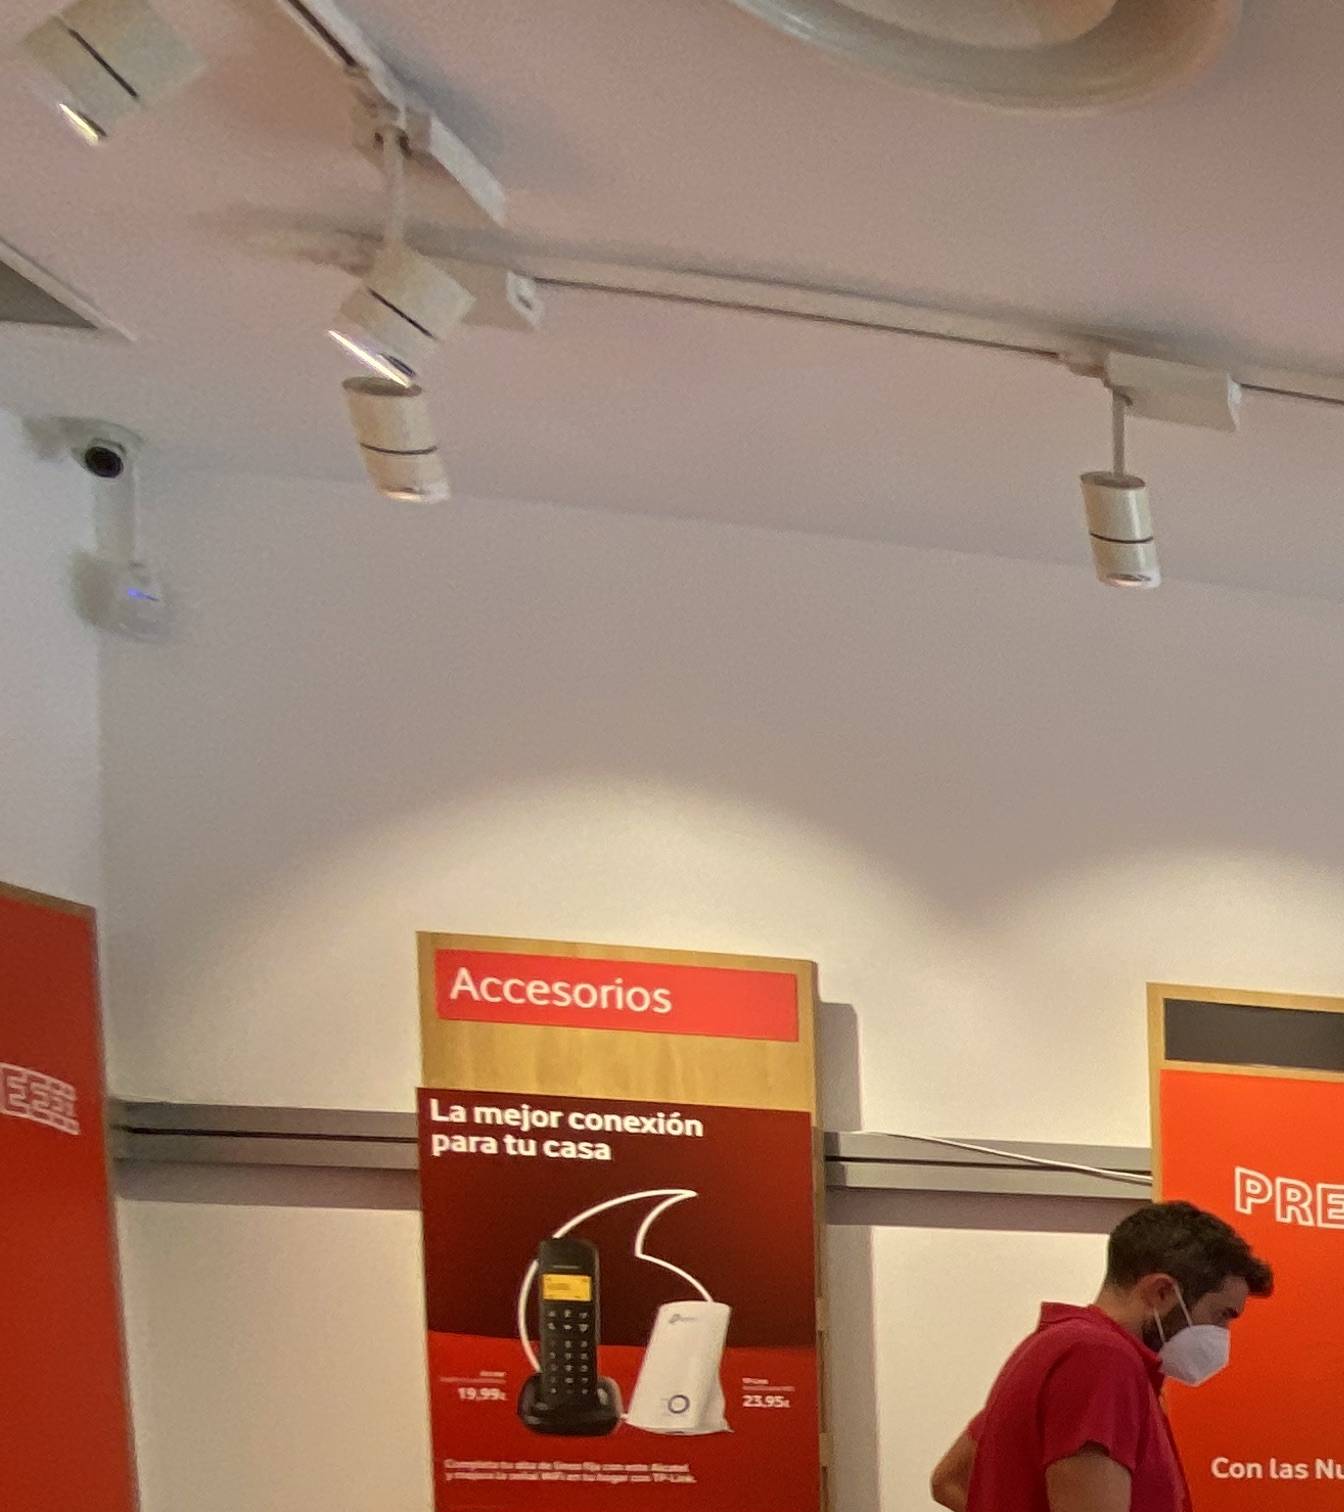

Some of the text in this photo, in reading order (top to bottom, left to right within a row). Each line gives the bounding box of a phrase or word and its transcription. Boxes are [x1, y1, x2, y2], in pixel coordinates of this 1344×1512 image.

[450, 967, 673, 1014] Accesorios
[430, 1098, 704, 1137] La mejor conexión
[432, 1133, 611, 1160] para tu casa
[1210, 1457, 1263, 1479] Con
[1269, 1458, 1309, 1479] las
